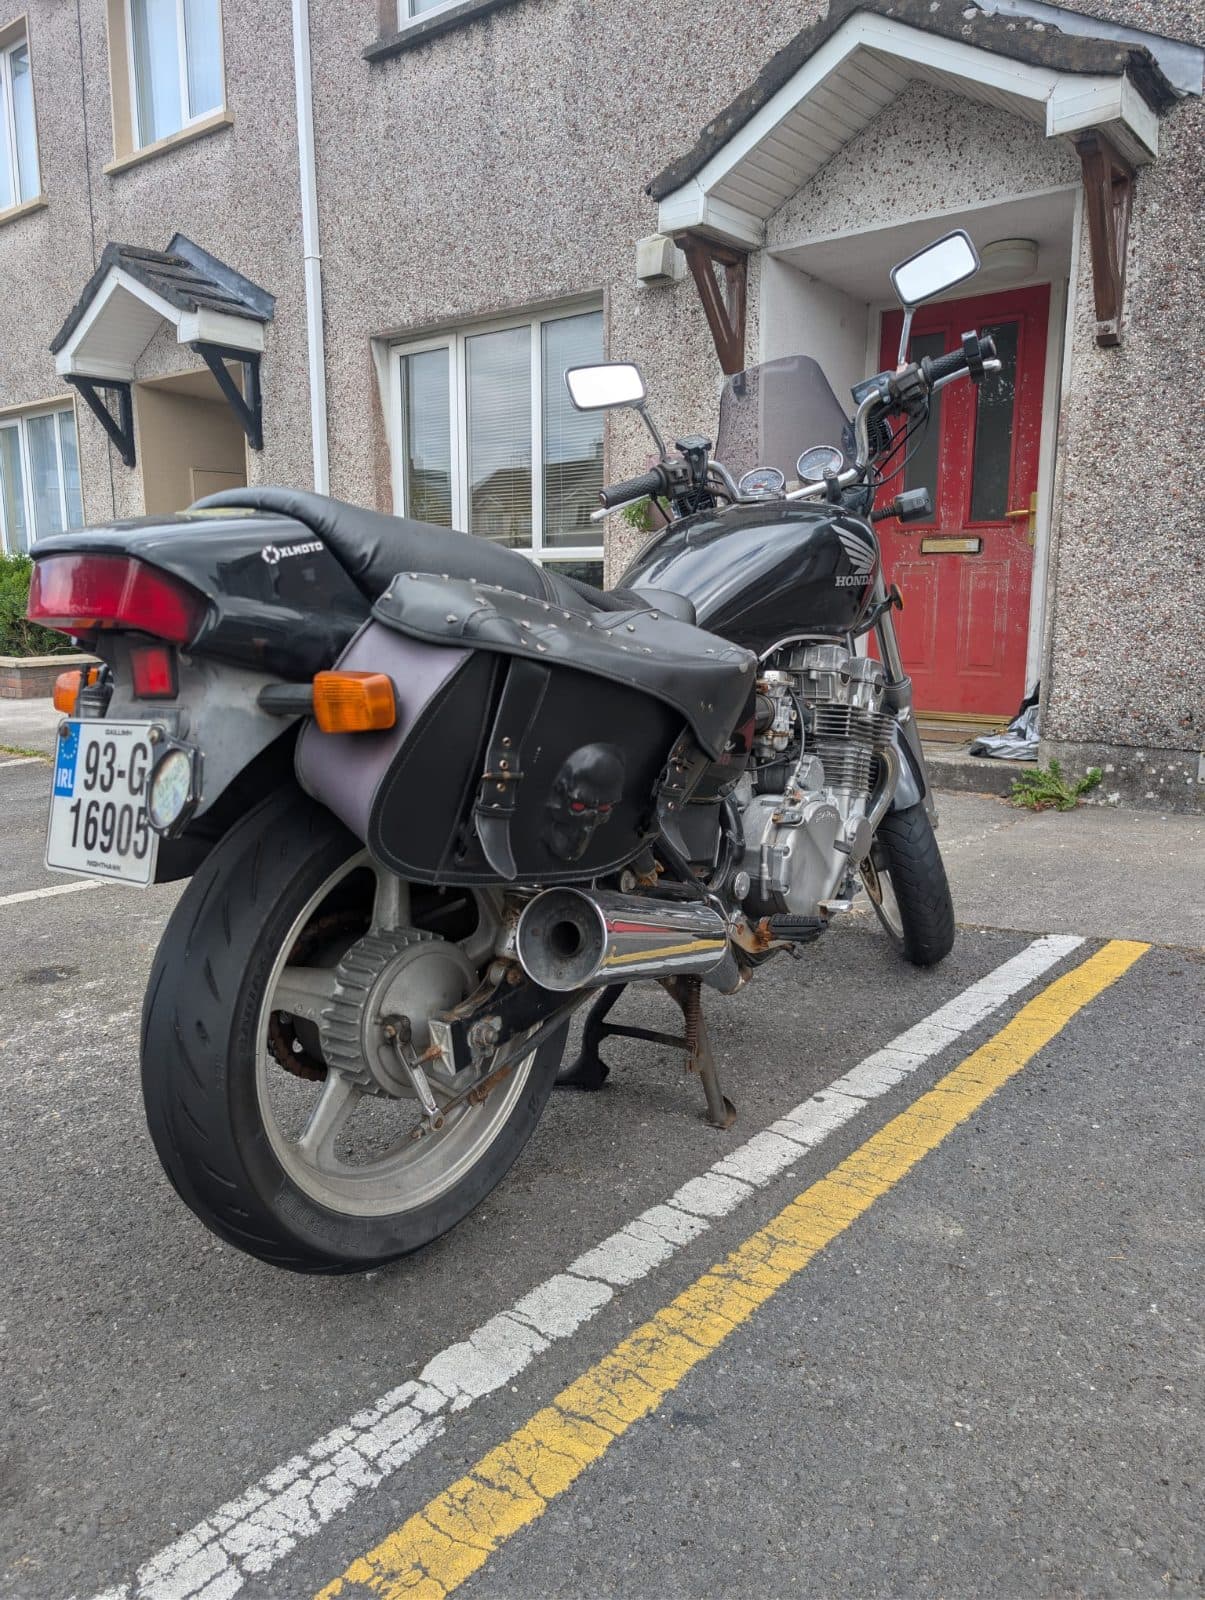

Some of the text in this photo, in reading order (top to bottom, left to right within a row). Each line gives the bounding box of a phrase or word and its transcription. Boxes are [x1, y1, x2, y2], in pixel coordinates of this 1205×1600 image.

[280, 541, 324, 558] XLMOTO
[835, 575, 874, 587] HONDA
[57, 768, 73, 788] IRL
[83, 740, 148, 796] 93-G
[70, 798, 149, 859] 16905
